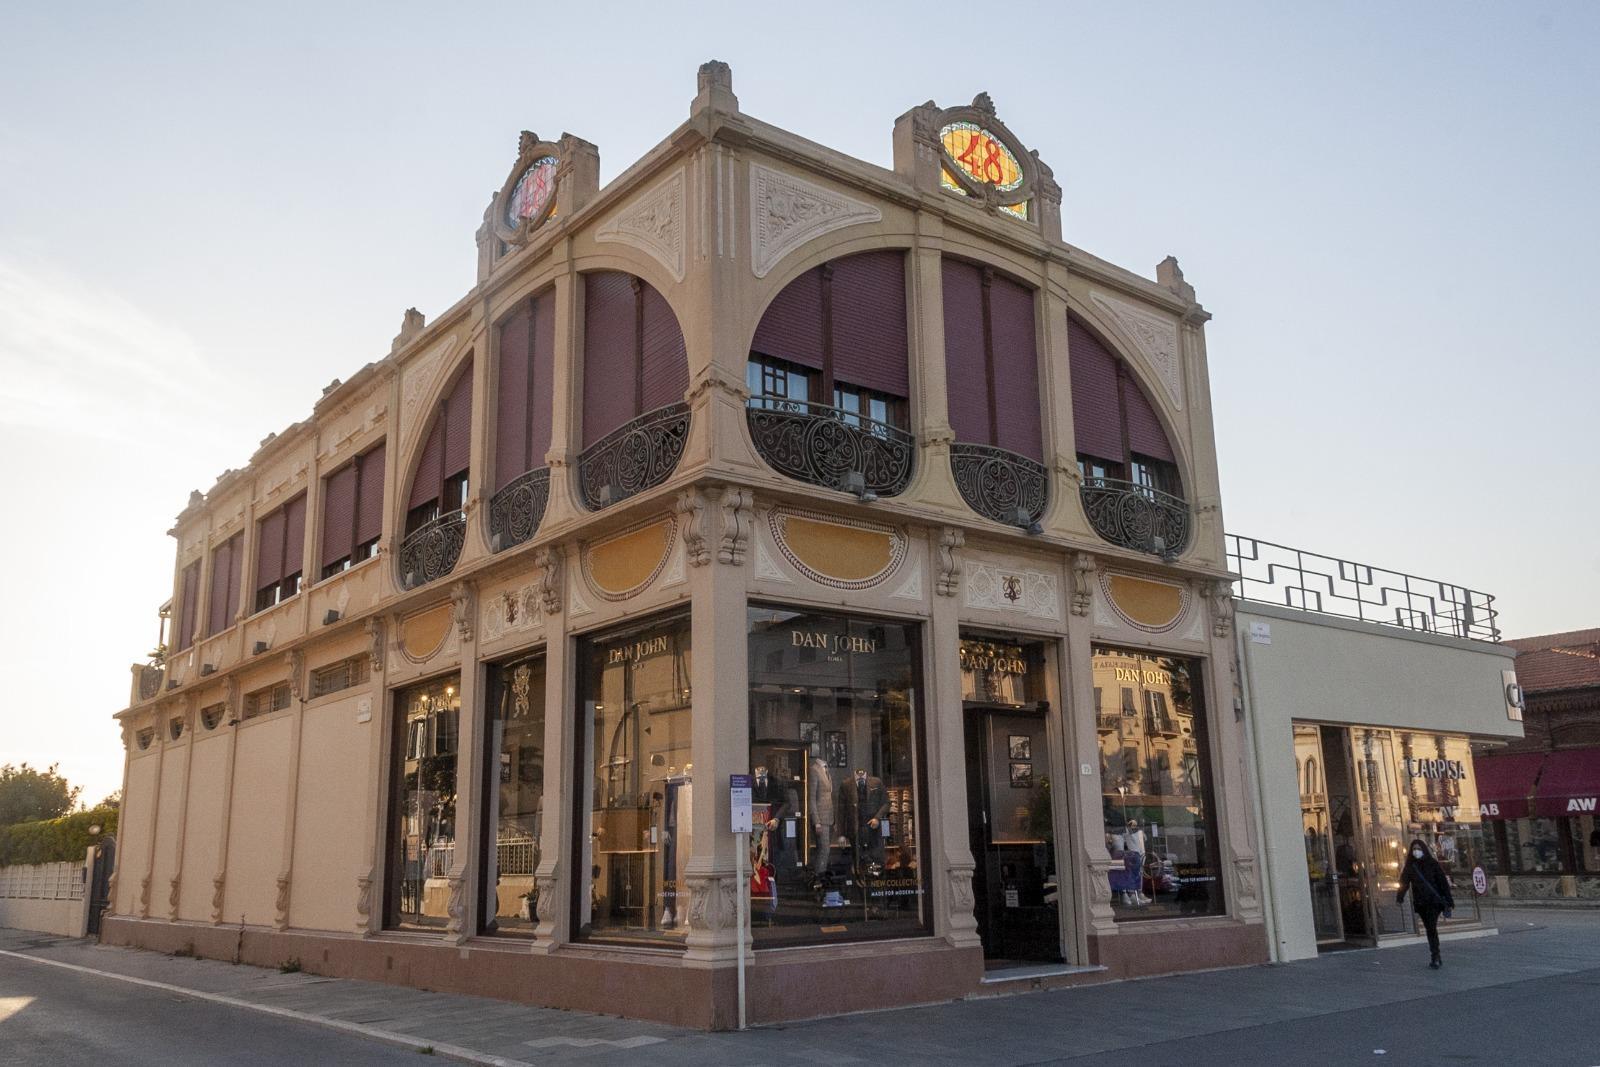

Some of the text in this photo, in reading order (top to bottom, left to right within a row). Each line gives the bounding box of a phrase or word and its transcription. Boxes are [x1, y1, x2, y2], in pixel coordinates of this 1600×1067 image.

[958, 134, 1004, 186] 48
[609, 635, 668, 664] DAN JOHN
[791, 630, 876, 655] DAN JOHN
[992, 657, 1027, 674] JOHN
[1114, 667, 1171, 687] DAN JOHN
[1407, 757, 1466, 779] CARPISA
[1567, 798, 1597, 812] AW
[871, 879, 886, 888] NEW
